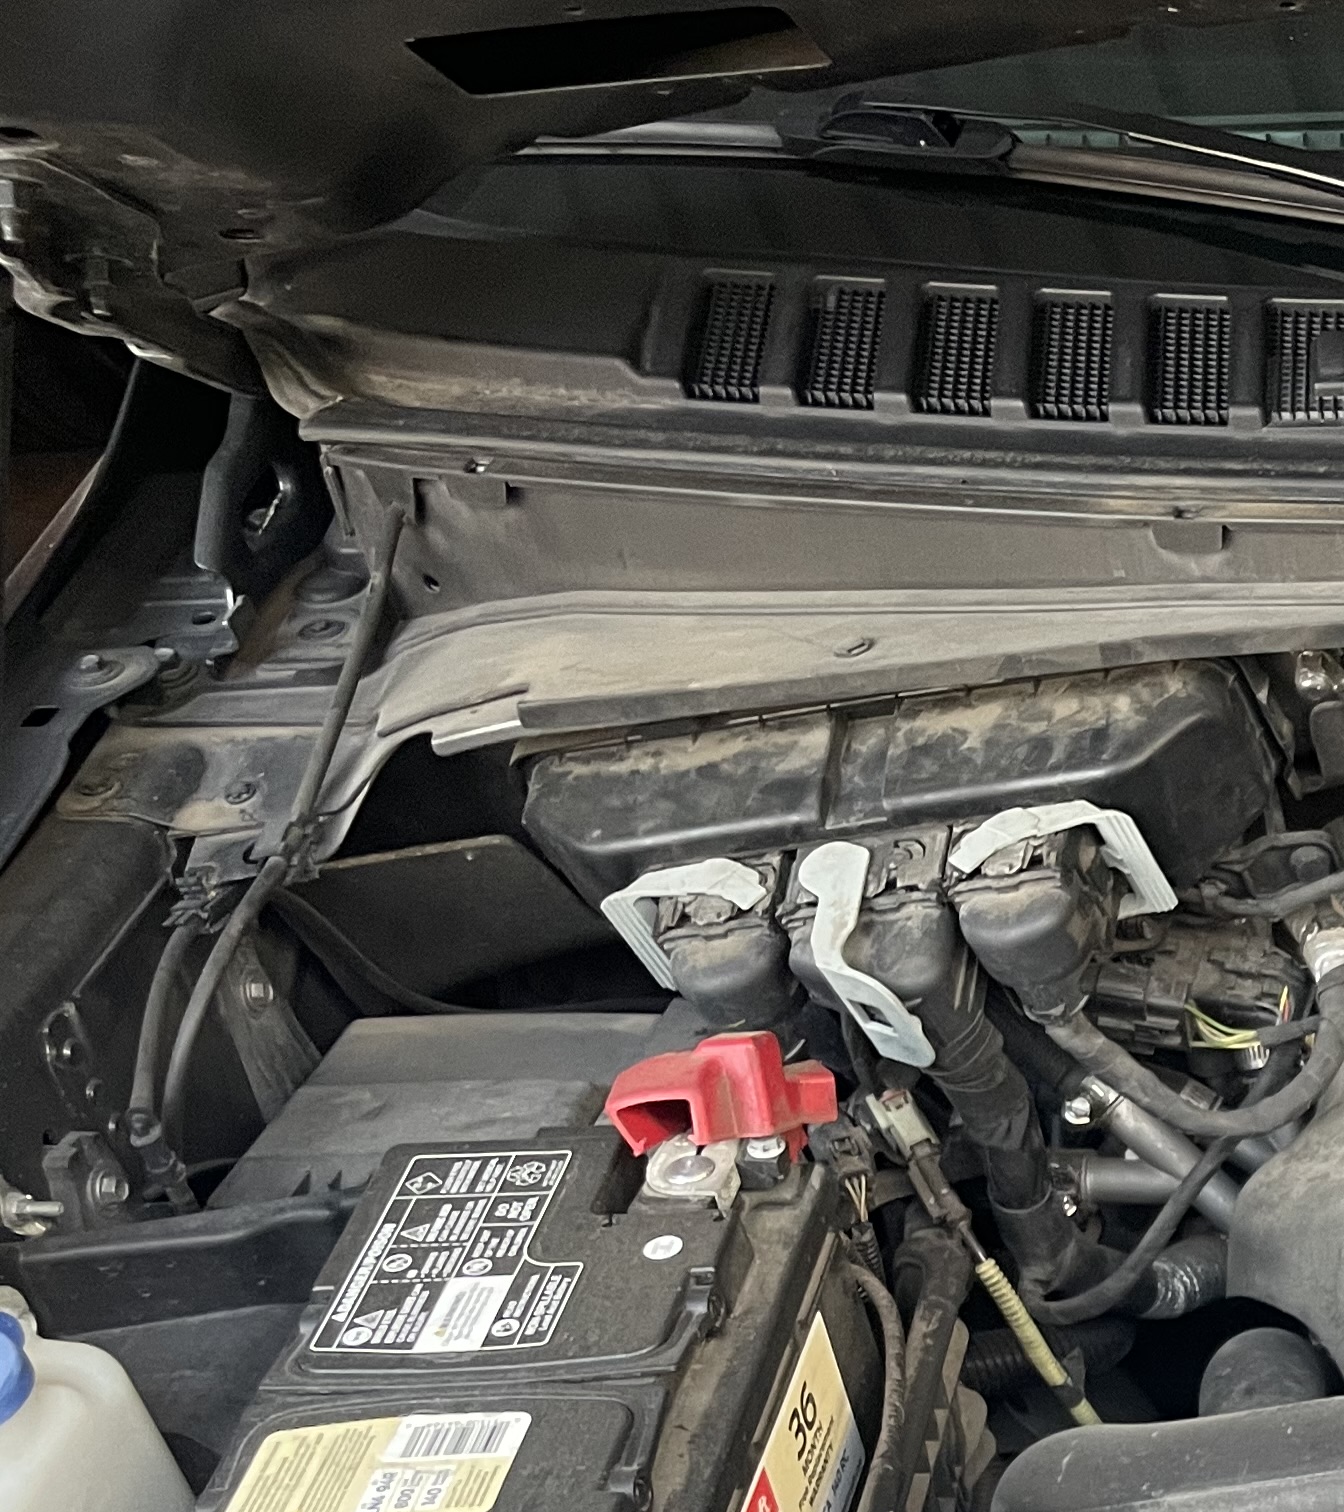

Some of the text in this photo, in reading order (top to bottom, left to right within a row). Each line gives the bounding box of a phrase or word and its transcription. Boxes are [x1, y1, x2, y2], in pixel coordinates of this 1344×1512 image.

[787, 1376, 818, 1464] 36
[801, 1417, 823, 1478] MONTH
[420, 1487, 443, 1505] 140
[808, 1439, 833, 1509] WARRANTY
[831, 1466, 842, 1497] 140
